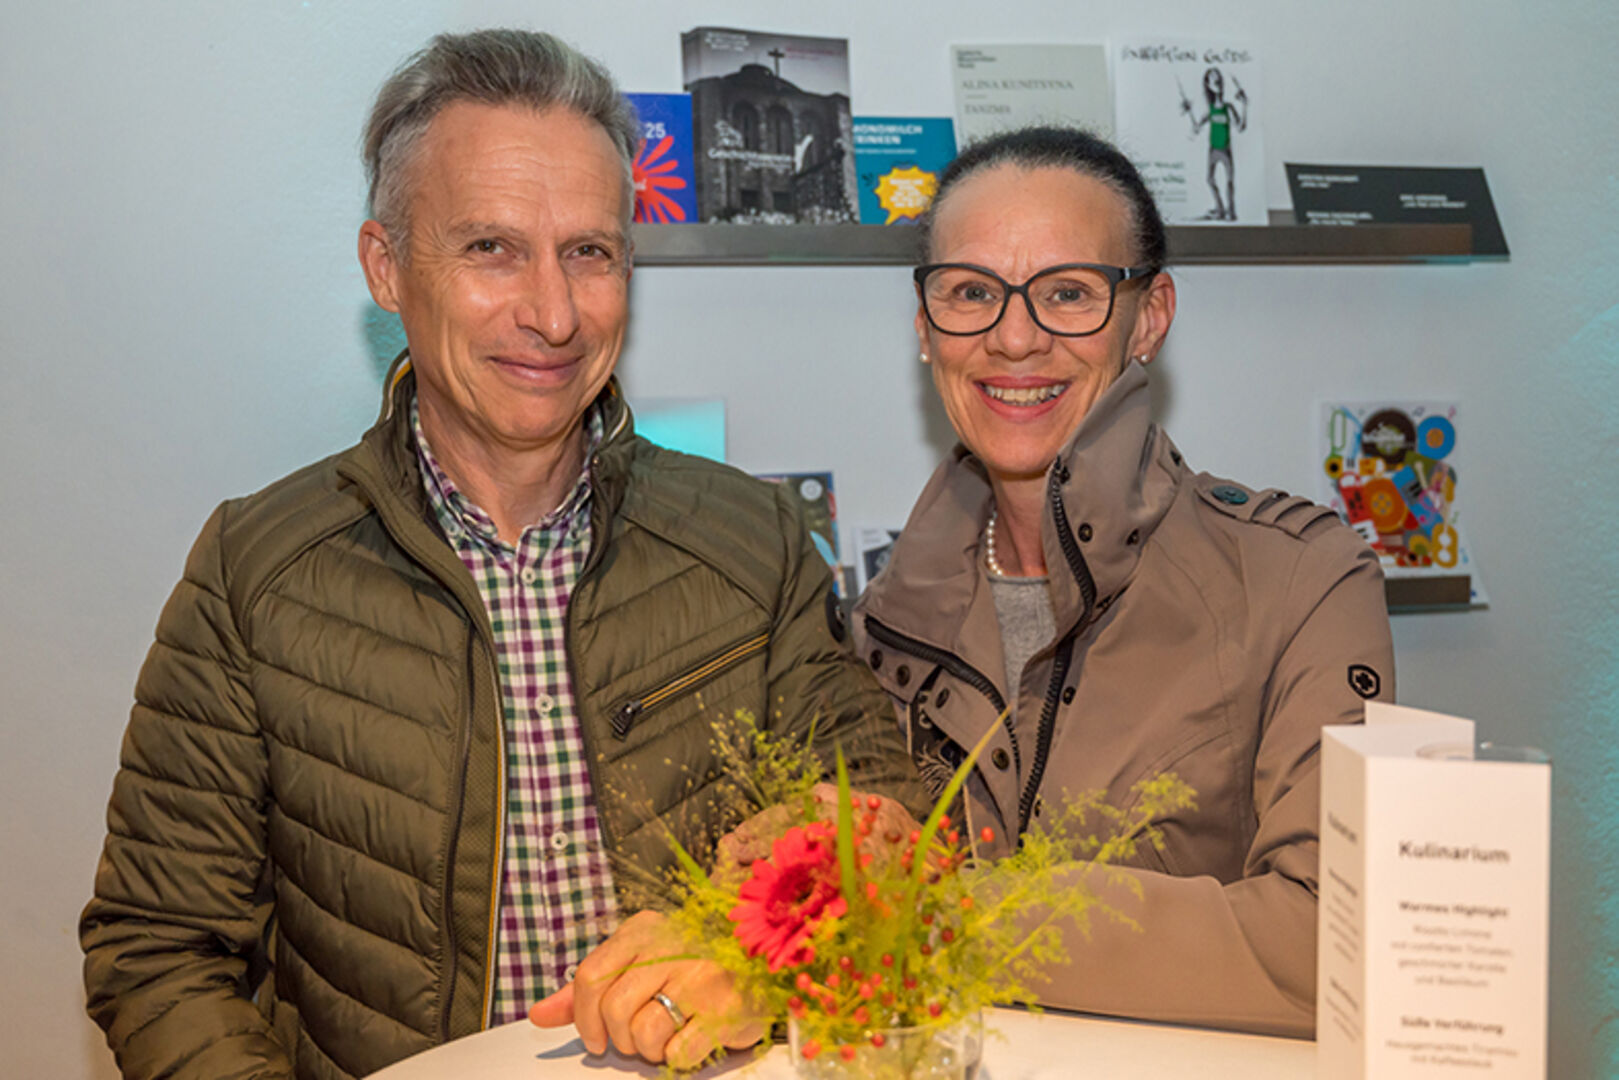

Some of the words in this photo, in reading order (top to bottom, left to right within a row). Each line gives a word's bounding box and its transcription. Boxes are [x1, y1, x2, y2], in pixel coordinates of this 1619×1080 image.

[645, 122, 666, 139] 25
[1398, 841, 1510, 863] Kulinarium
[1452, 903, 1508, 919] Highlight
